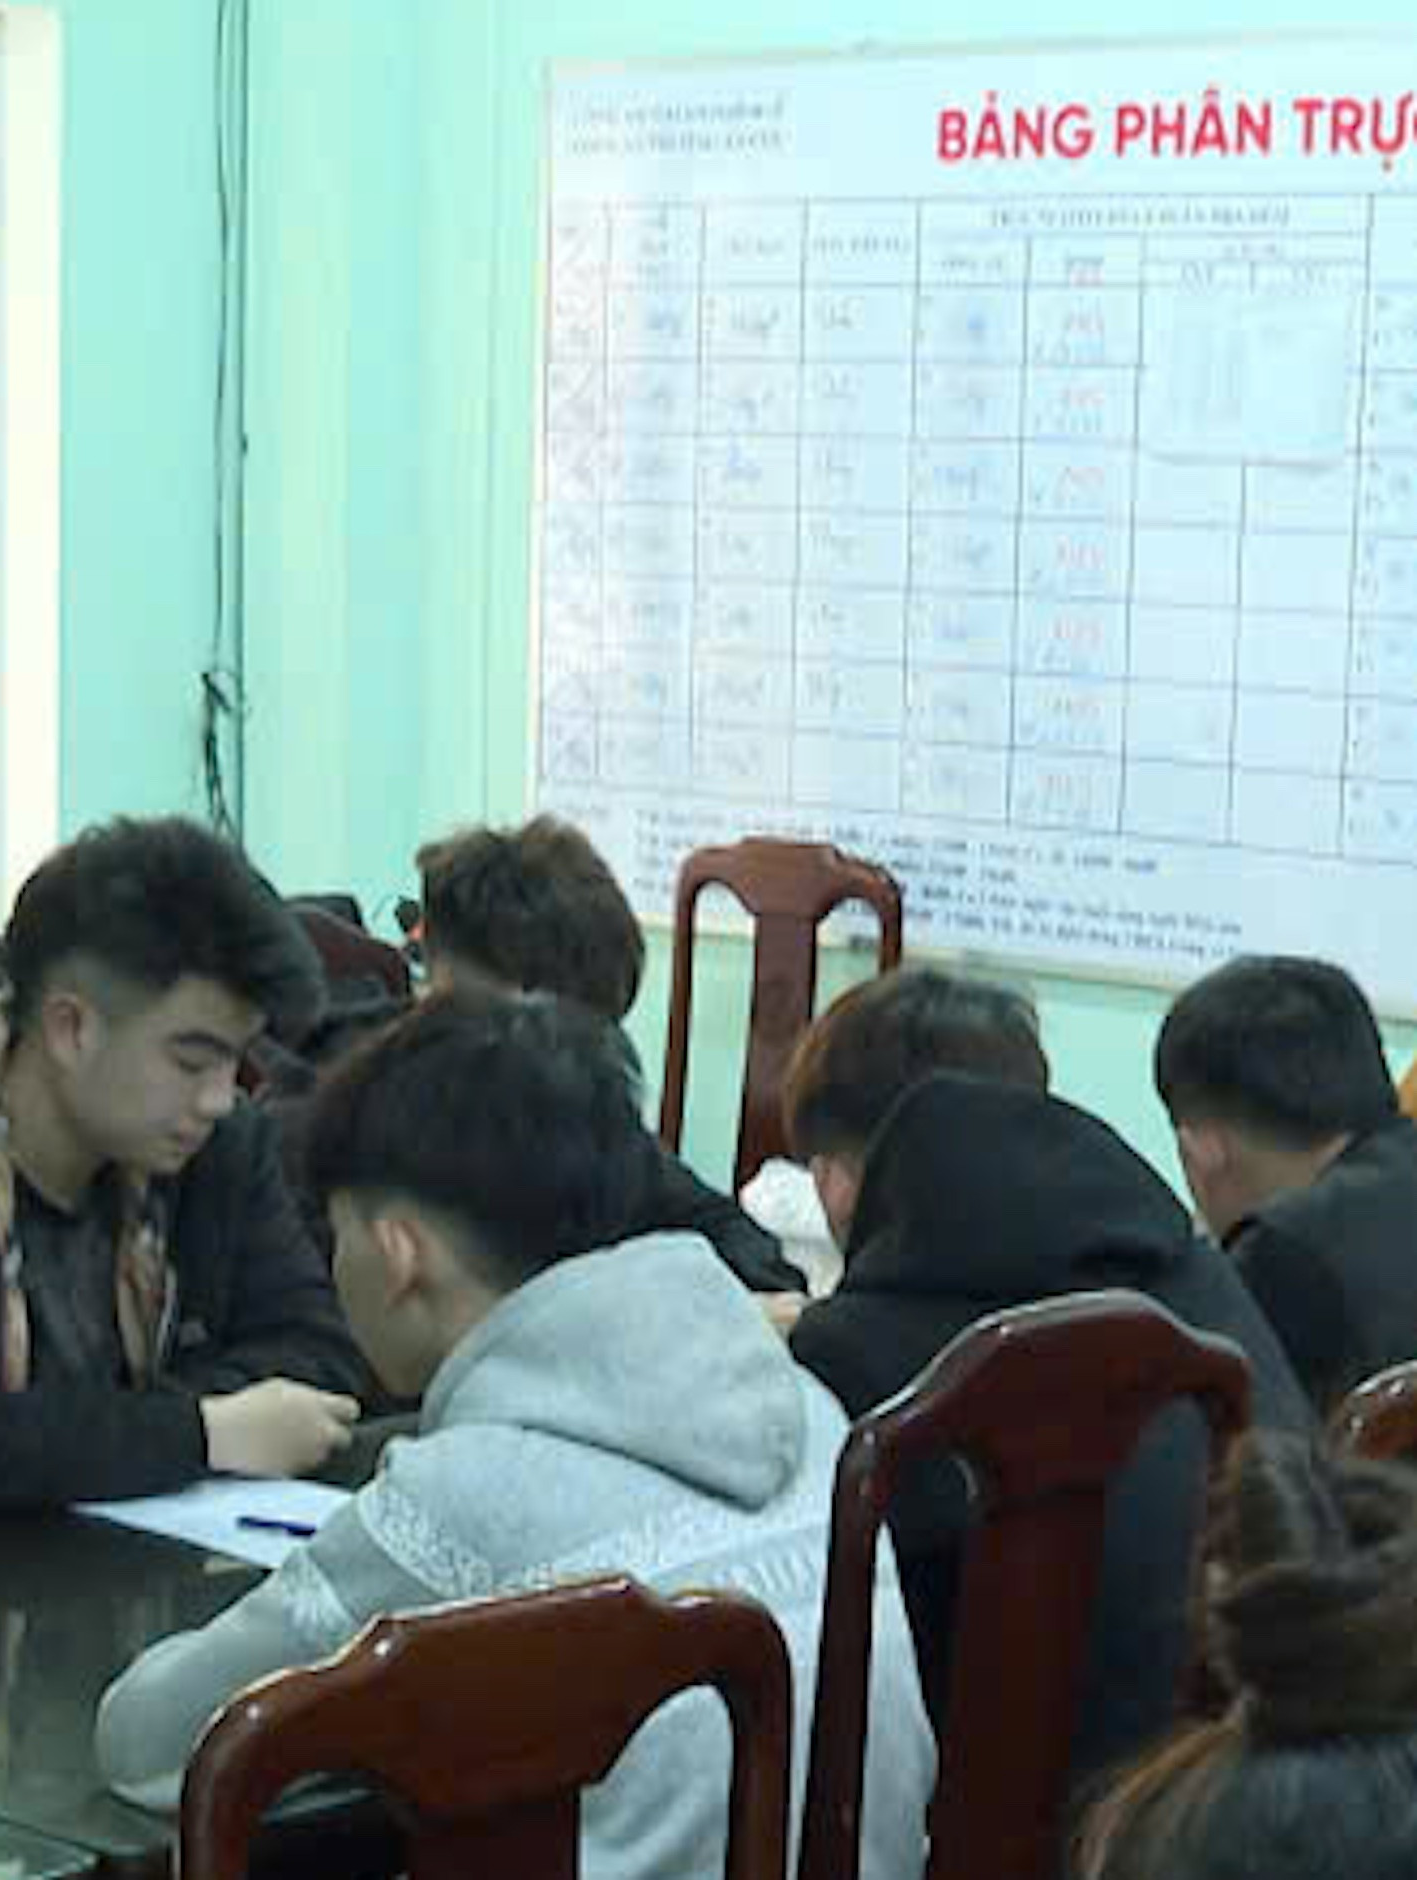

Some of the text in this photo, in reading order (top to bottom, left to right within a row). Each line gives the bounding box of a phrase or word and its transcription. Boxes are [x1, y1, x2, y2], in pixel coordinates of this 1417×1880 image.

[937, 83, 1417, 172] BẢNG PHÂN TRỰ
